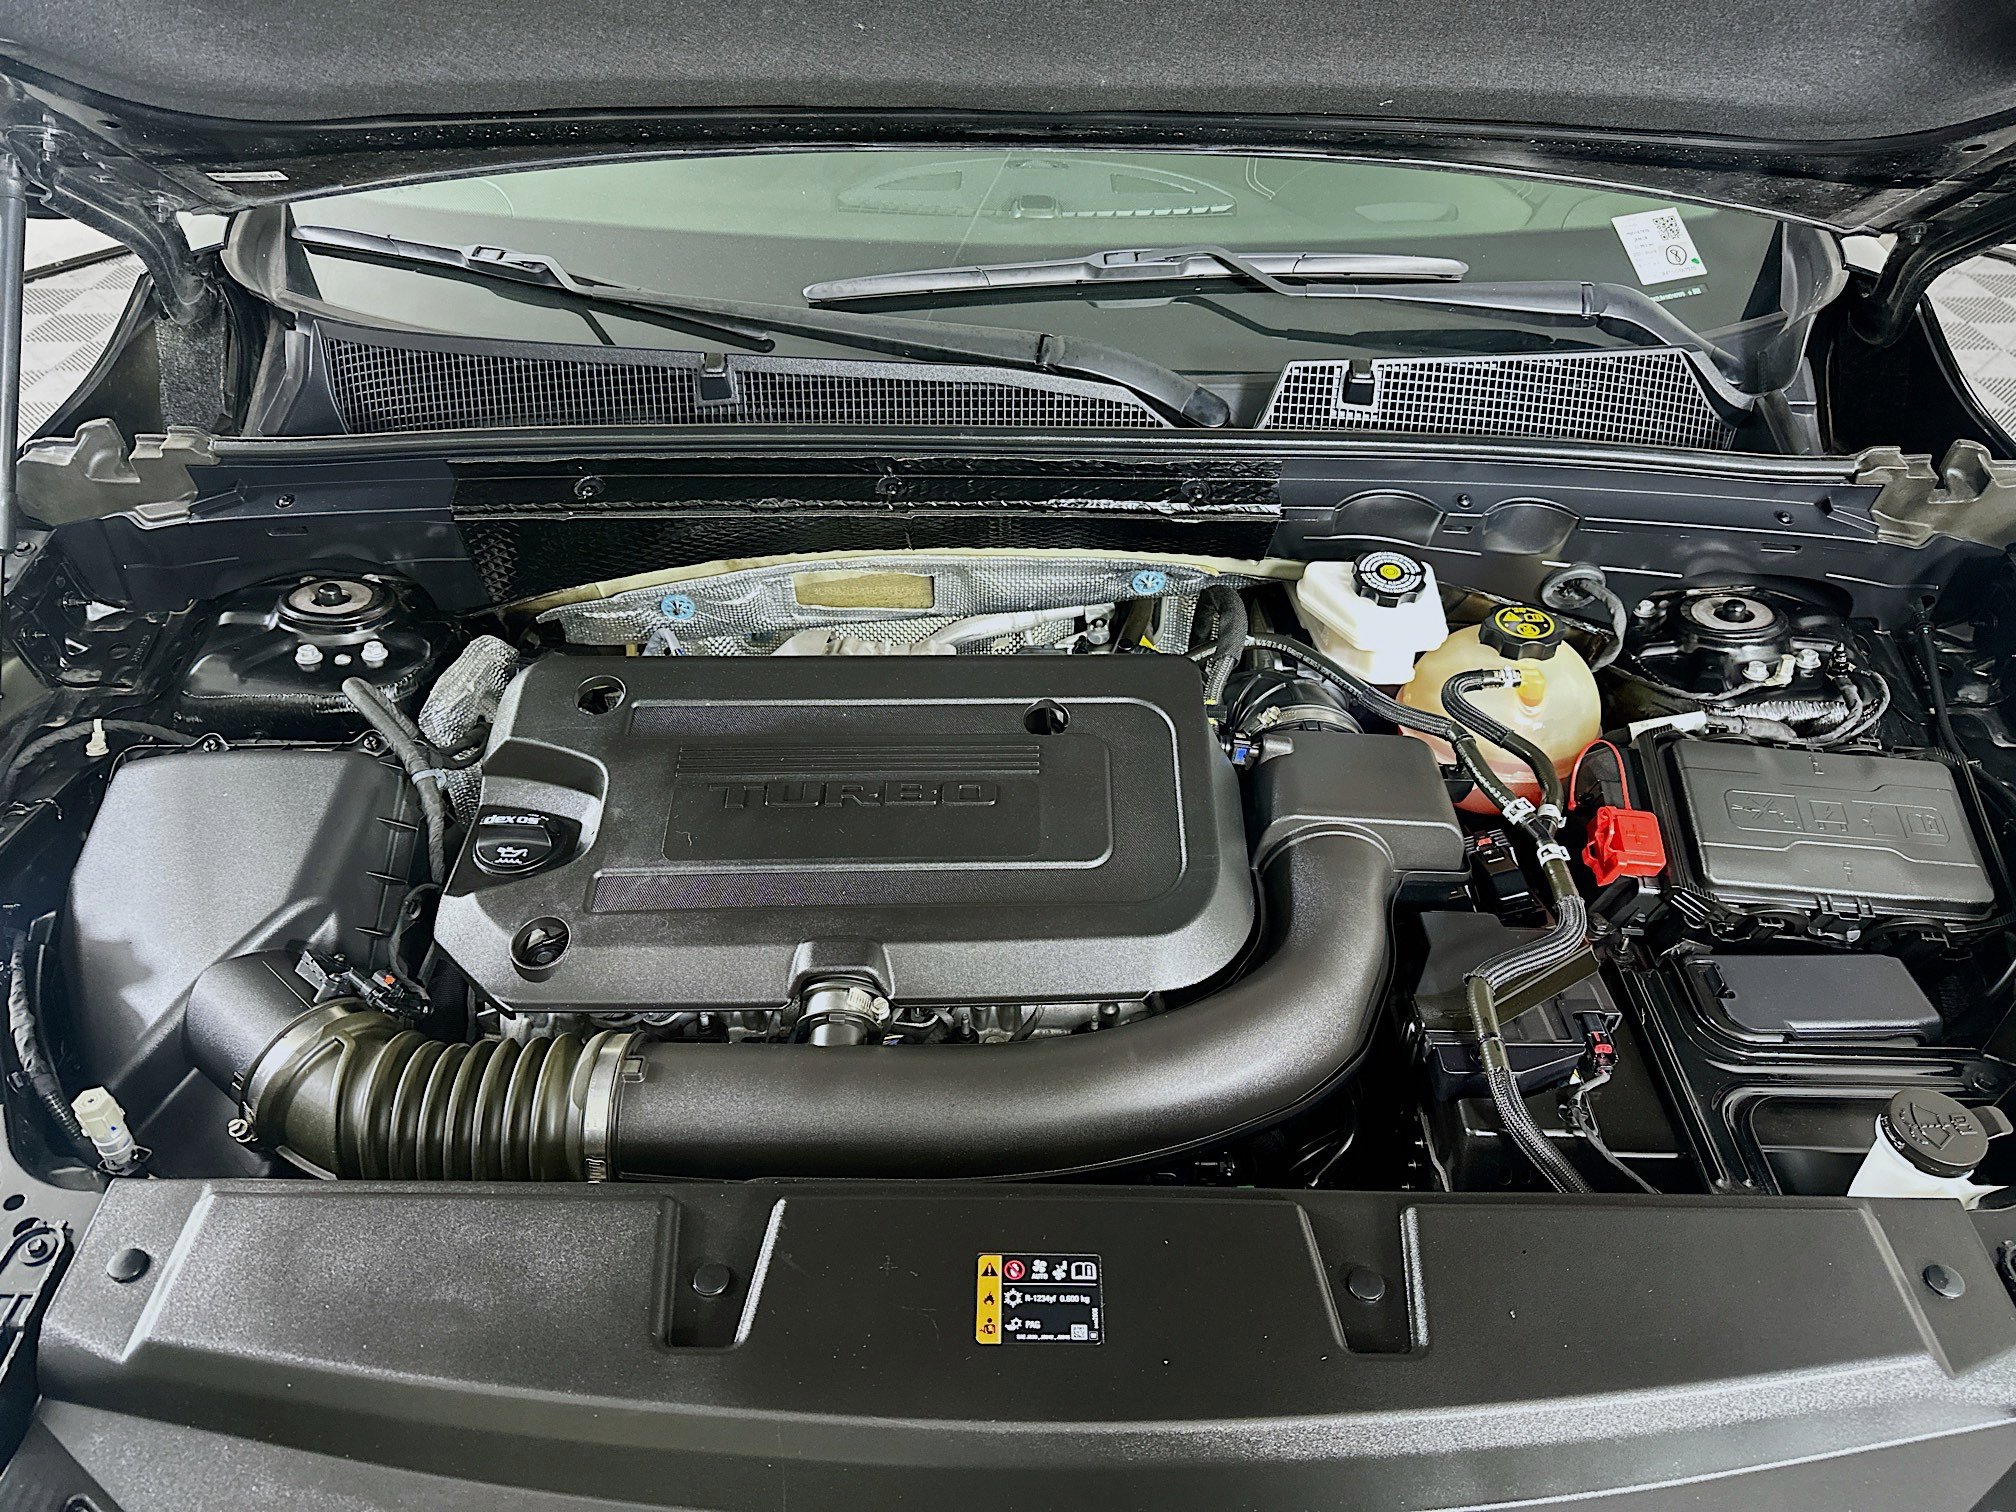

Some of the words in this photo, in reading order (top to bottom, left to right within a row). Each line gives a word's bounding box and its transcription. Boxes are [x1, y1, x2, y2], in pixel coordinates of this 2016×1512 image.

[709, 782, 997, 808] TURBO
[1080, 1295, 1091, 1304] kg
[1025, 1320, 1041, 1329] PAG
